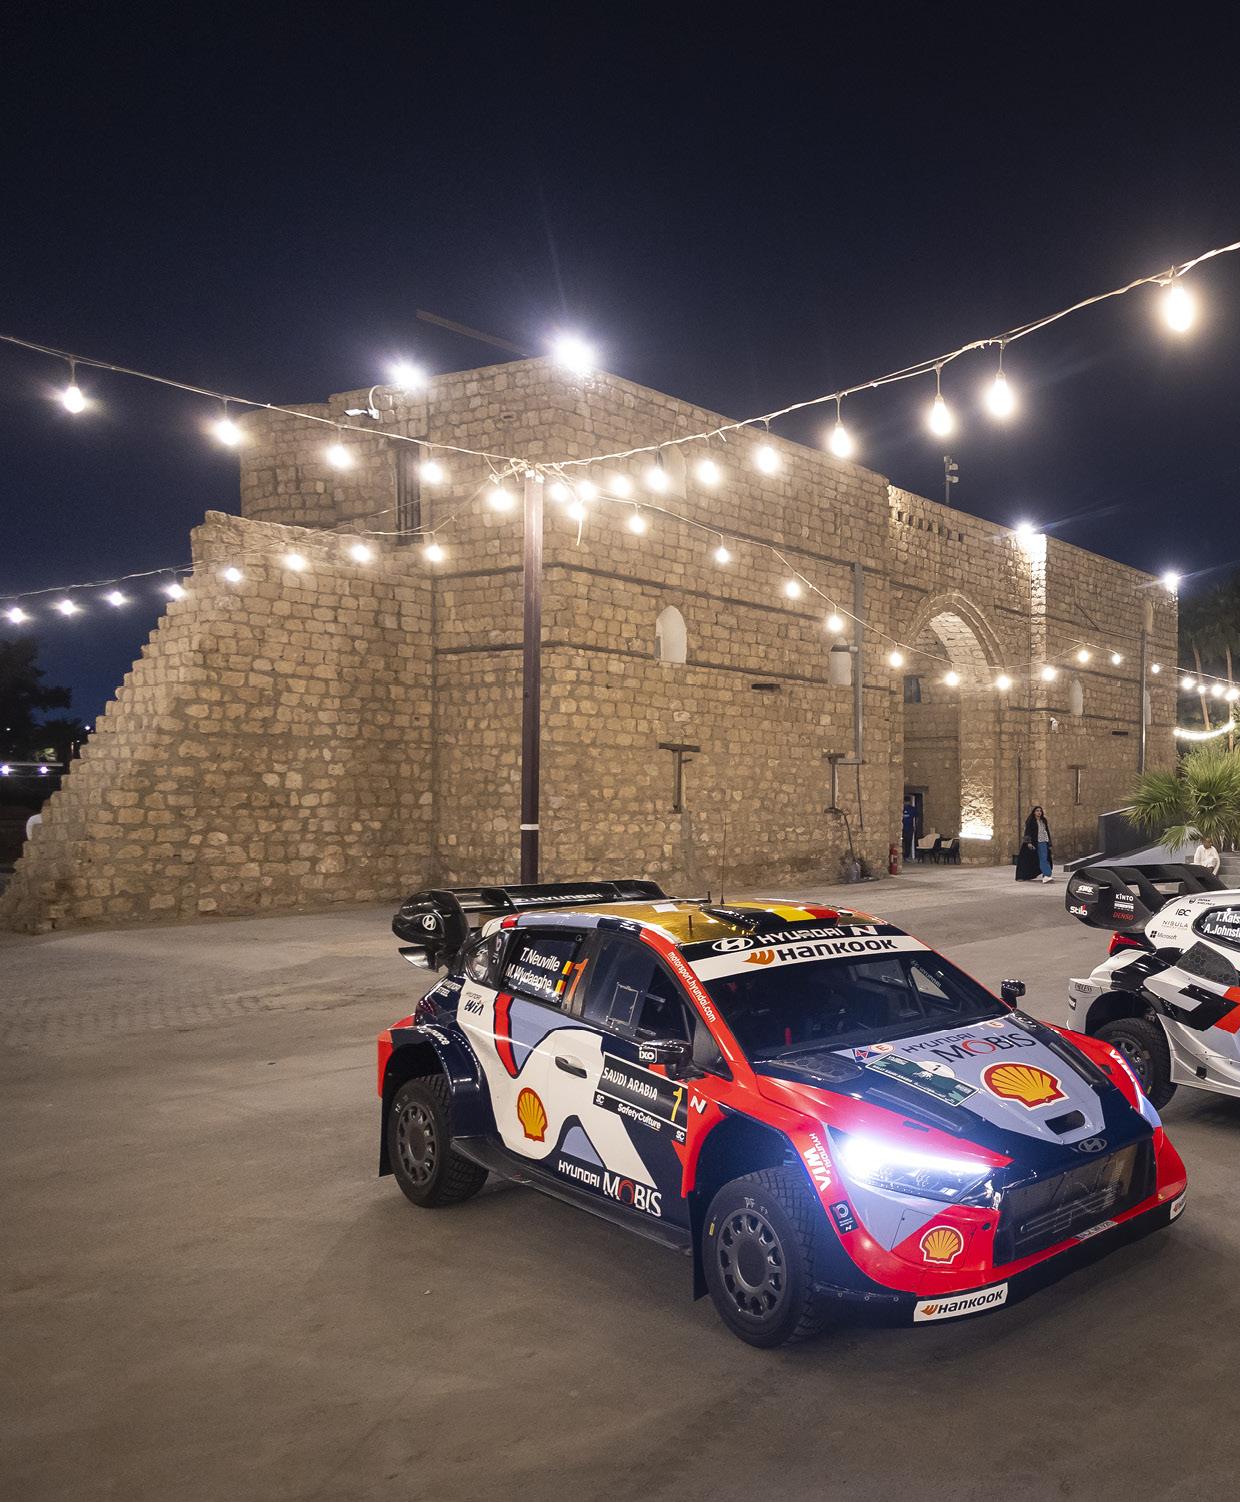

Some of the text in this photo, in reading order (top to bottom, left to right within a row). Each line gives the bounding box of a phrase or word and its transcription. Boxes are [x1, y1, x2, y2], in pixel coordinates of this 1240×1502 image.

[1070, 904, 1088, 916] Stilo
[1115, 893, 1134, 901] KINTO
[1113, 912, 1134, 920] DENSO
[1162, 920, 1189, 928] NISULA
[757, 927, 845, 944] HYUNDAI
[520, 947, 561, 971] T.Neuville
[505, 963, 552, 990] M.Wydaeghe
[567, 958, 589, 1001] 1
[668, 951, 716, 1023] motorsport.hyundai.com
[901, 1032, 977, 1053] HYUNDAI
[930, 1033, 1037, 1063] MOBIS
[602, 1067, 658, 1101] SAUDI ARABIA
[617, 1103, 661, 1129] SafetyCulture
[670, 1087, 682, 1122] 1
[809, 1132, 832, 1168] HYUNDAI
[558, 1160, 662, 1217] HYUNDAI MOBIS
